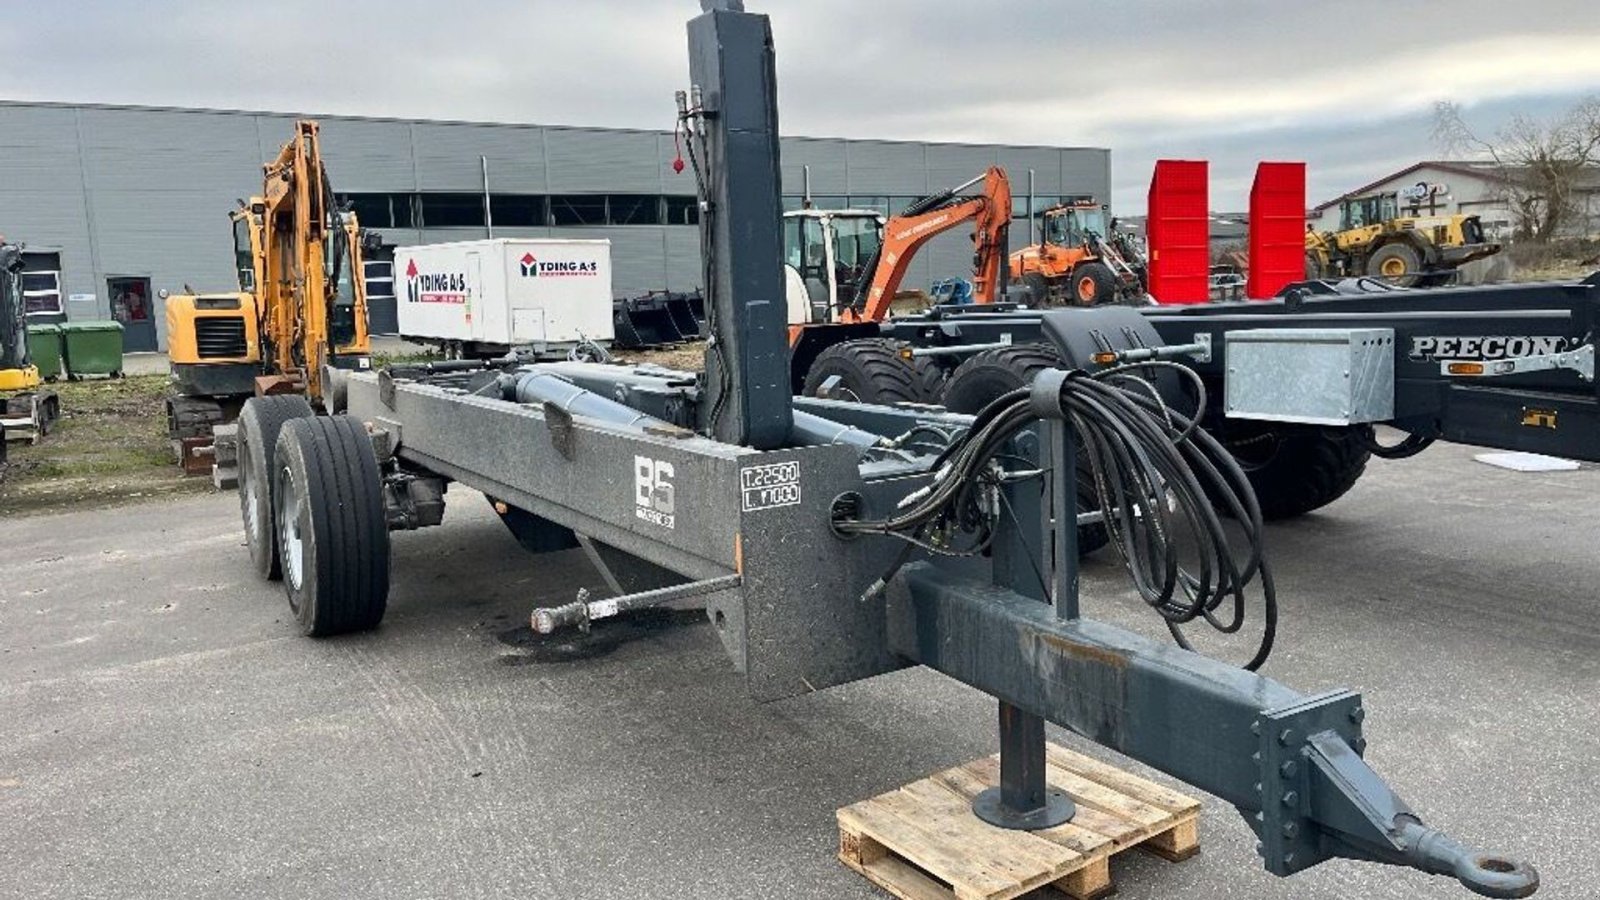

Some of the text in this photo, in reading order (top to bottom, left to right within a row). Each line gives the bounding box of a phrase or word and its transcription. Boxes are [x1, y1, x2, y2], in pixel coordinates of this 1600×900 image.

[539, 262, 577, 271] YDING
[419, 273, 448, 292] YDING
[1409, 336, 1567, 360] PEECON
